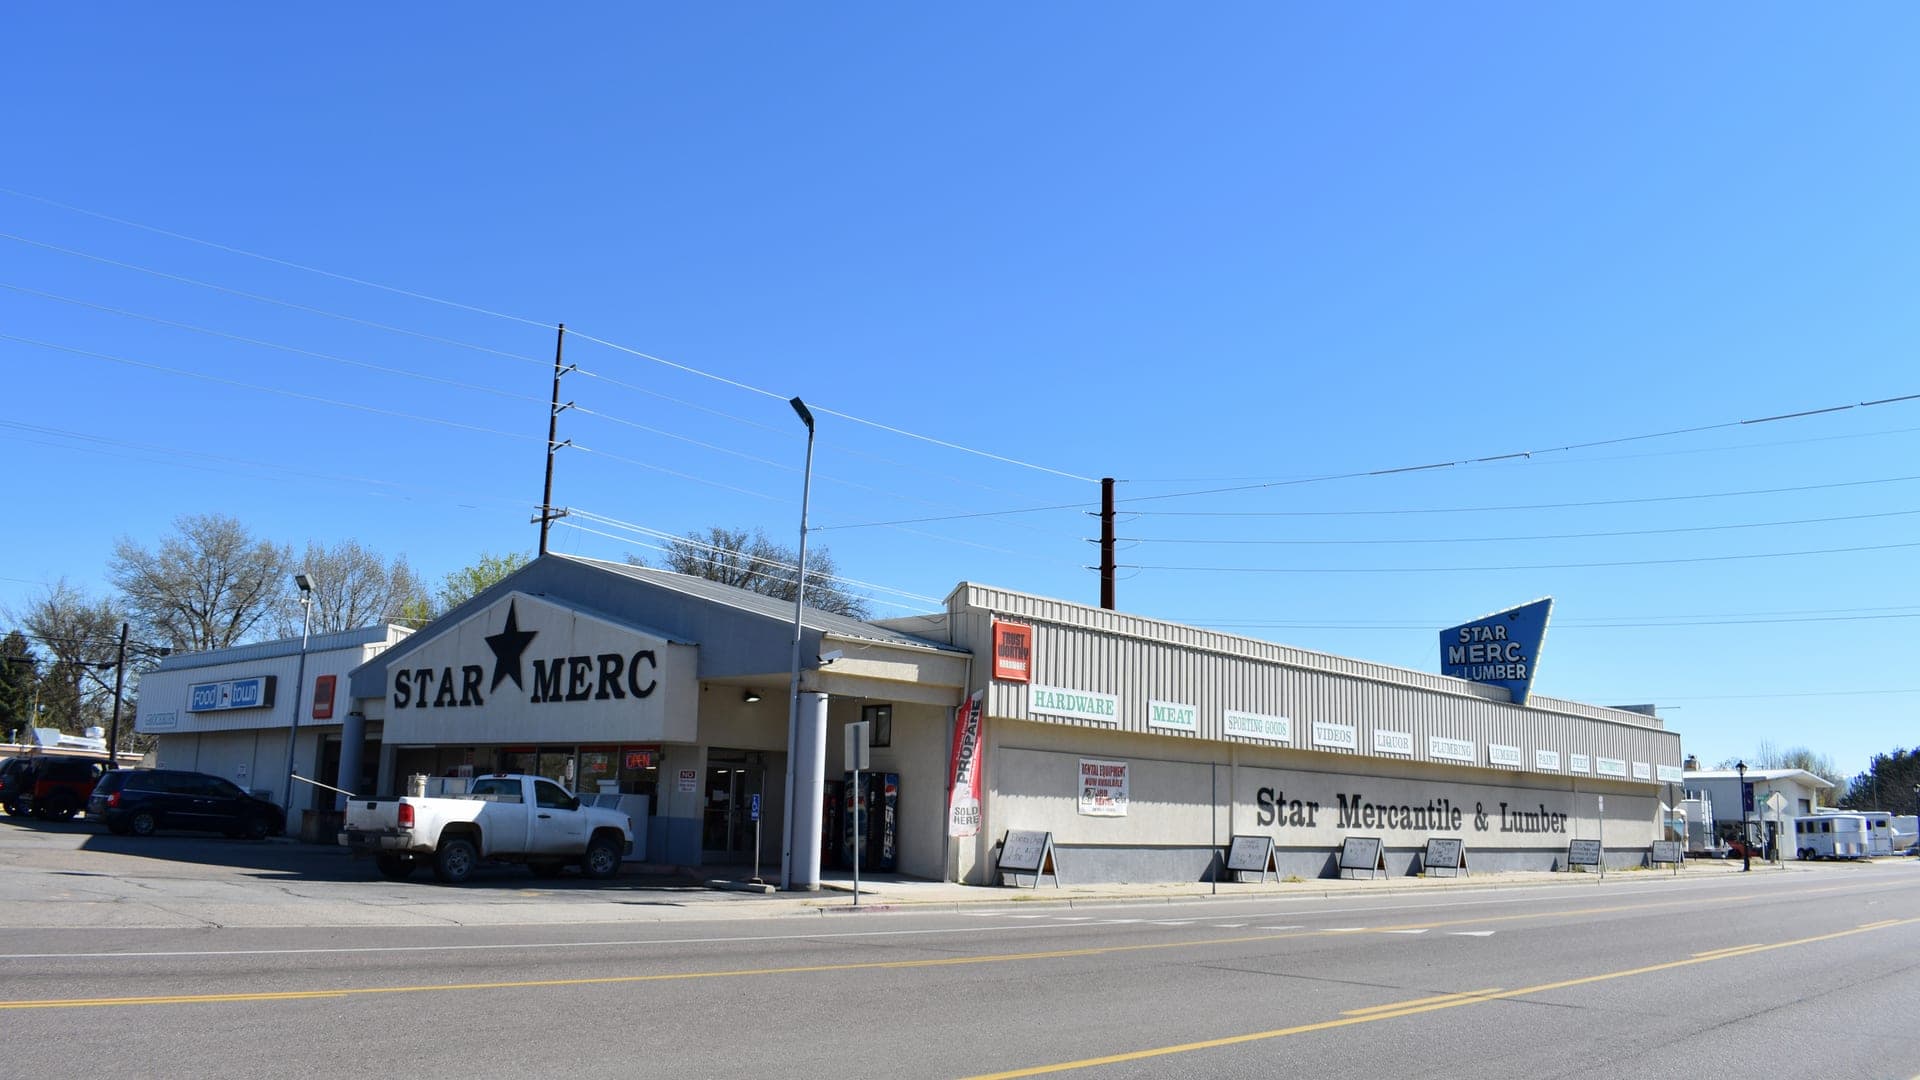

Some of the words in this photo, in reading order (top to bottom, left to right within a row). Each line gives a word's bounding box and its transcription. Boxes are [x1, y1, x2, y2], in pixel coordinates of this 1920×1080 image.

[1001, 632, 1025, 646] TRUST
[1460, 625, 1507, 643] STAR
[998, 645, 1028, 660] WORTHY
[1448, 642, 1527, 665] MERC.
[394, 665, 484, 709] STAR
[530, 650, 657, 703] MERC
[1464, 664, 1527, 681] LUMBER
[1034, 690, 1114, 716] HARDWARE
[1152, 705, 1194, 725] MEAT
[1228, 715, 1263, 733] SPORTING
[1264, 720, 1287, 736] GOODS
[956, 700, 981, 785] PROPANE
[1316, 727, 1352, 743] VIDEOS
[1376, 734, 1409, 750] LIQUOR
[1431, 740, 1473, 757] PLUMBING
[626, 752, 650, 769] OPEN
[1100, 764, 1126, 777] EQUIPMENT
[954, 806, 978, 817] SOLD
[1257, 787, 1319, 828] Star
[1336, 793, 1462, 832] Mercantile
[1474, 801, 1489, 832] &
[1499, 802, 1567, 834] Lumber
[953, 815, 980, 826] HERE
